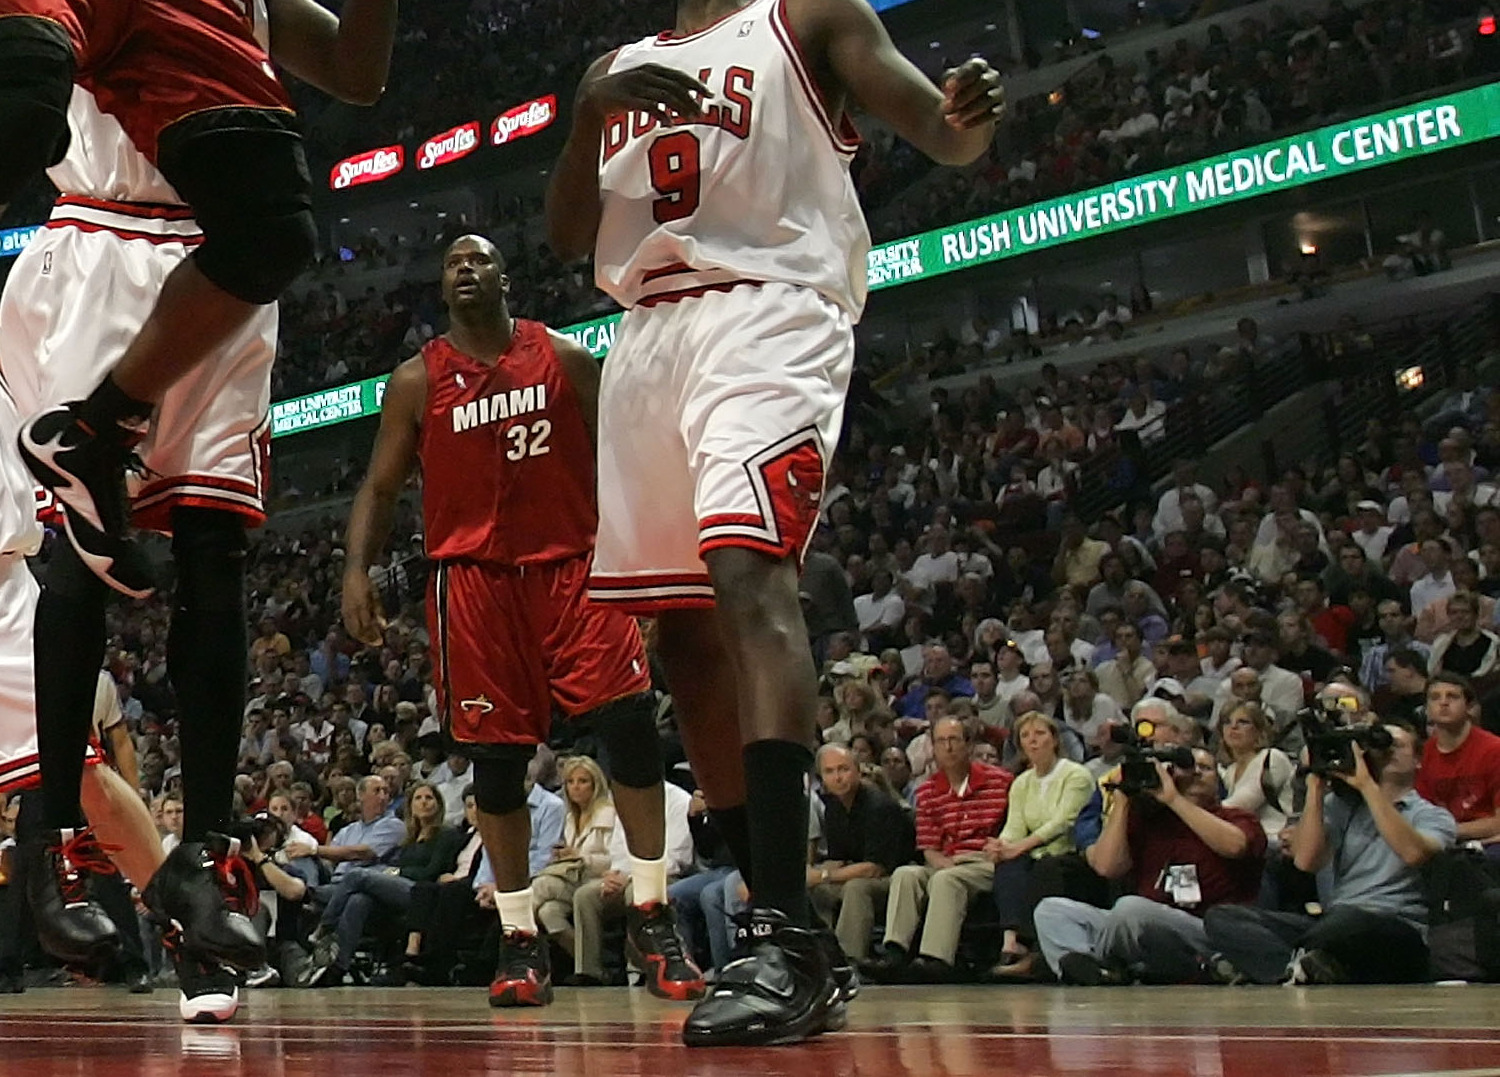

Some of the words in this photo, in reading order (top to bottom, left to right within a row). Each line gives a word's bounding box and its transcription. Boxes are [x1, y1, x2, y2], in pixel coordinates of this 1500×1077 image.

[648, 129, 701, 224] 9
[942, 219, 1011, 265] RUSH
[1017, 174, 1178, 245] UNIVERSITY
[1187, 139, 1326, 200] MEDICAL
[1331, 104, 1461, 165] CENTER
[453, 384, 546, 433] MIAMI
[507, 419, 552, 462] 32
